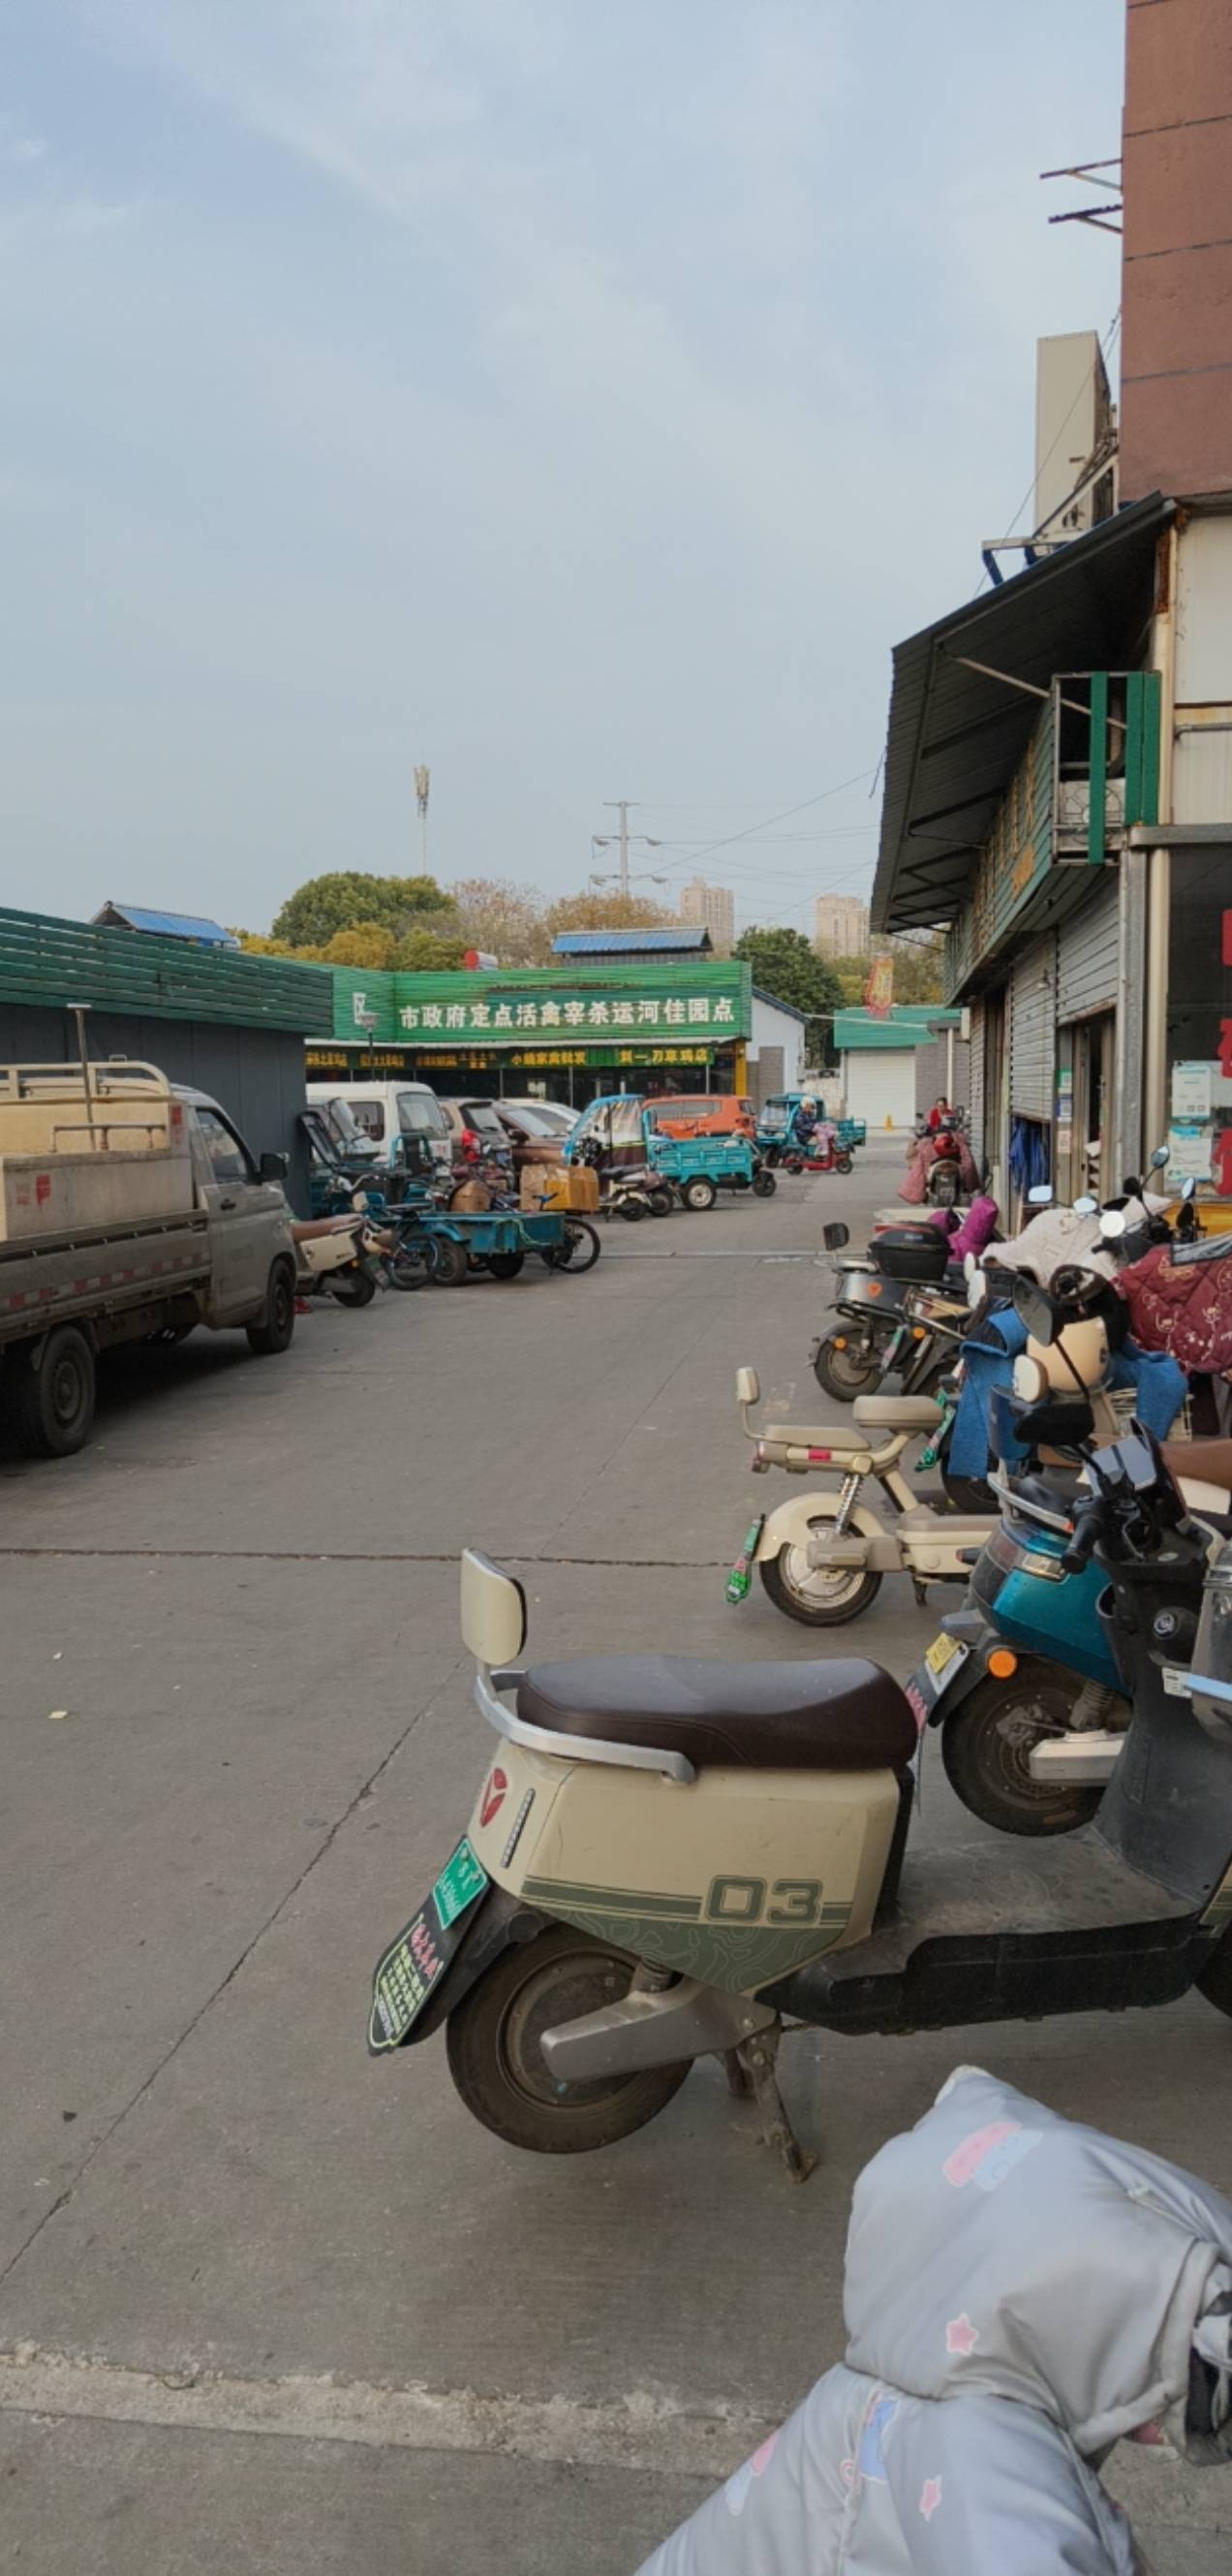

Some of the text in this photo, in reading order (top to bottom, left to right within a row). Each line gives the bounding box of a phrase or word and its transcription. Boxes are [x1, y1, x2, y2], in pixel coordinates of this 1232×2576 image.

[399, 997, 734, 1029] 市政府定点活禽宰杀运河佳园点
[705, 1875, 823, 1926] 03
